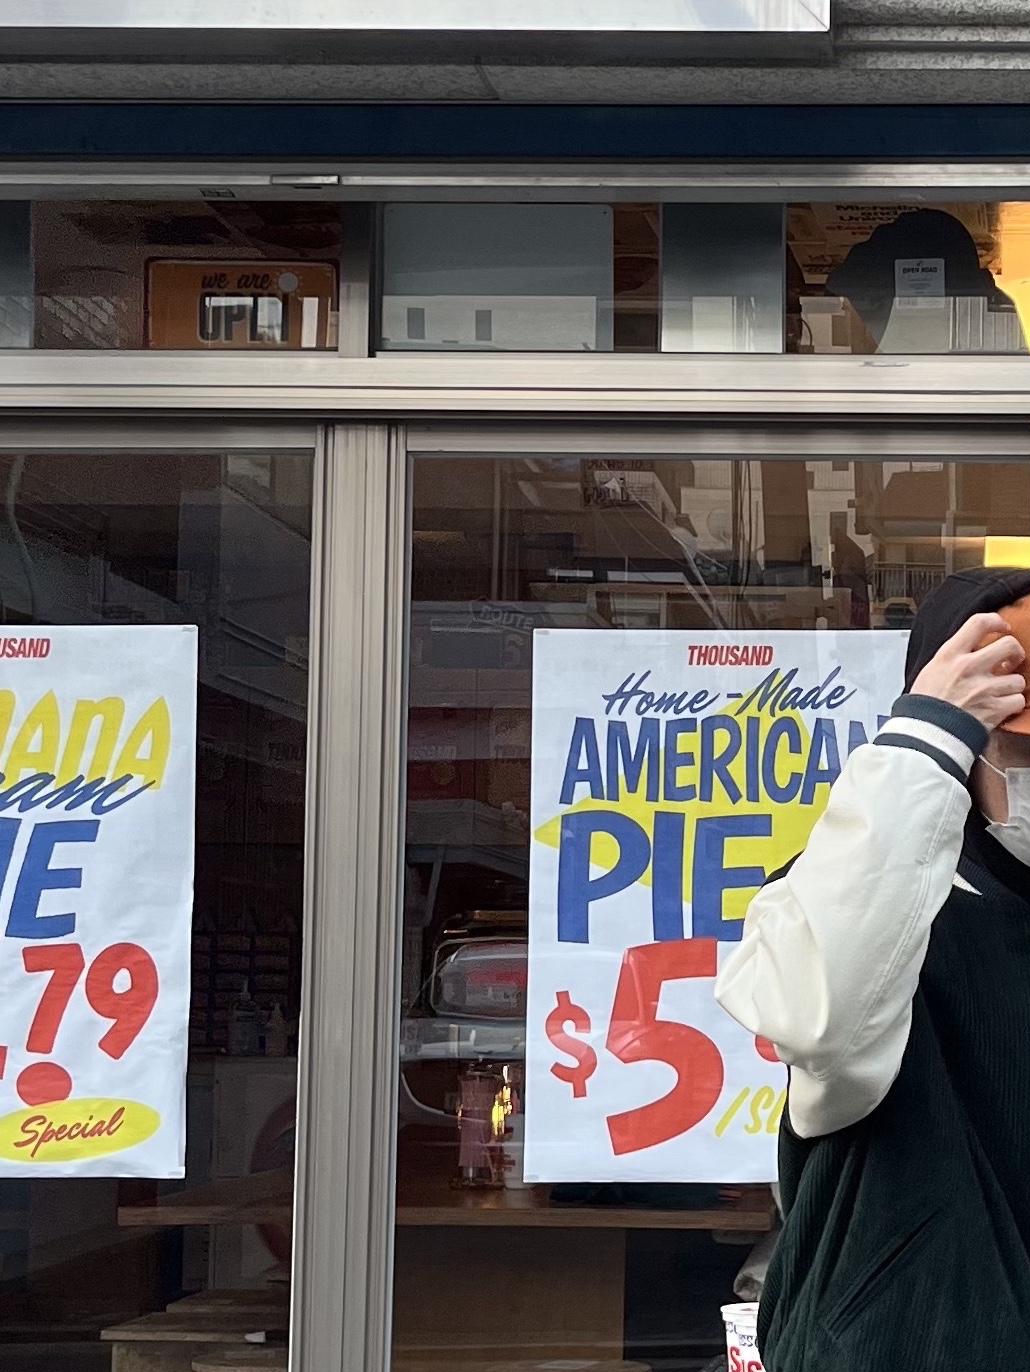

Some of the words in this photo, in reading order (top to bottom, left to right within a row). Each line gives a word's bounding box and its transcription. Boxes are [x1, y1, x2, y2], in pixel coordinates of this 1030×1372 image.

[202, 273, 229, 289] we
[237, 273, 271, 289] are
[688, 645, 774, 667] THOUSAND
[0, 771, 156, 816] am
[558, 811, 772, 943] PIE
[14, 1107, 126, 1158] Special
